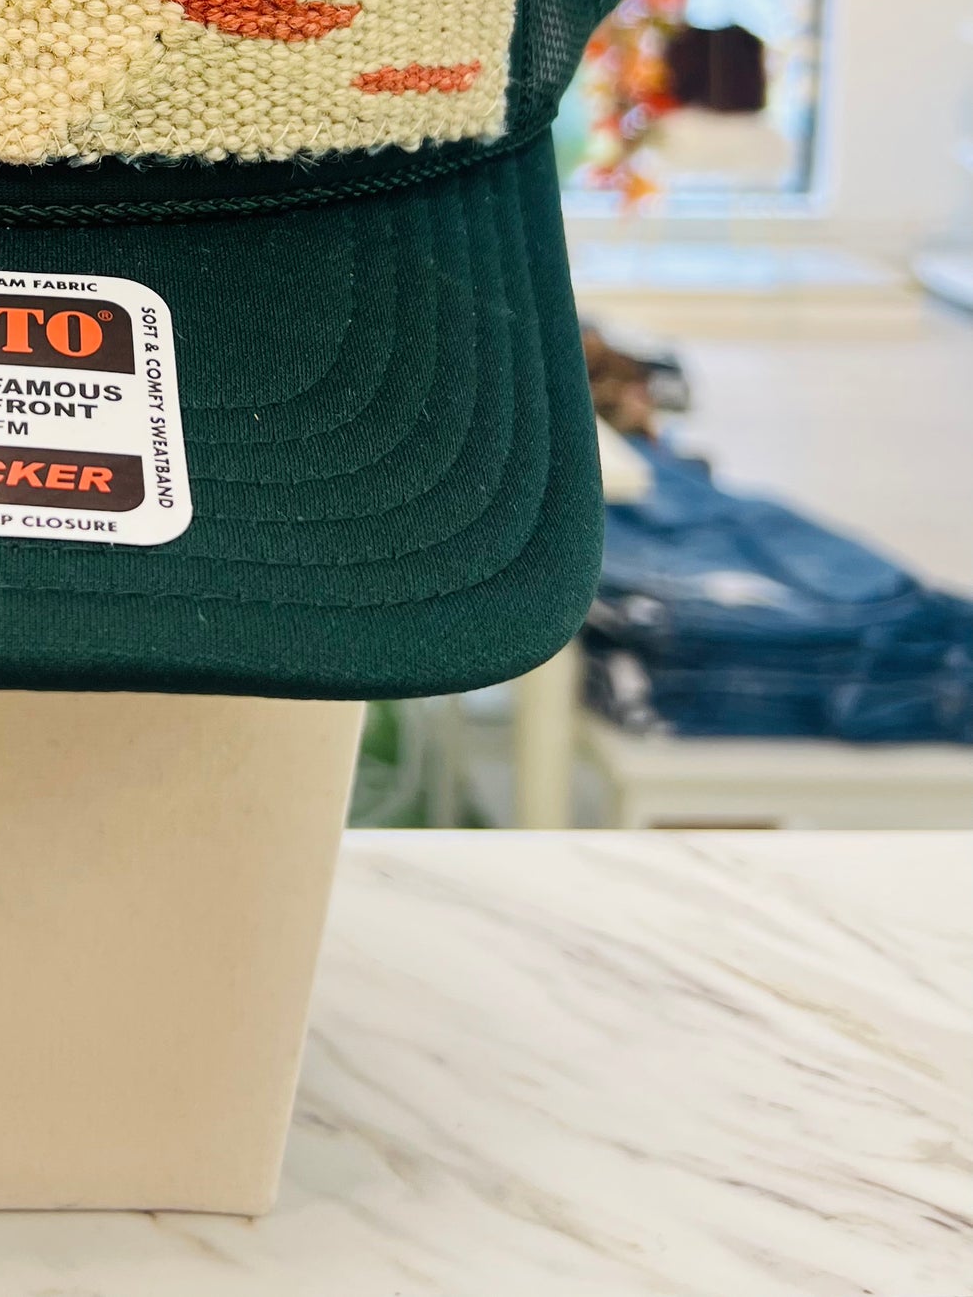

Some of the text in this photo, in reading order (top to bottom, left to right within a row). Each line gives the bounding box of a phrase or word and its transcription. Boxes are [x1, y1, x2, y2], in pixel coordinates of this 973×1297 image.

[33, 279, 98, 292] FABRIC
[141, 306, 174, 509] SOFT & COMFY SWEATBAND
[21, 515, 118, 532] CLOSURE
